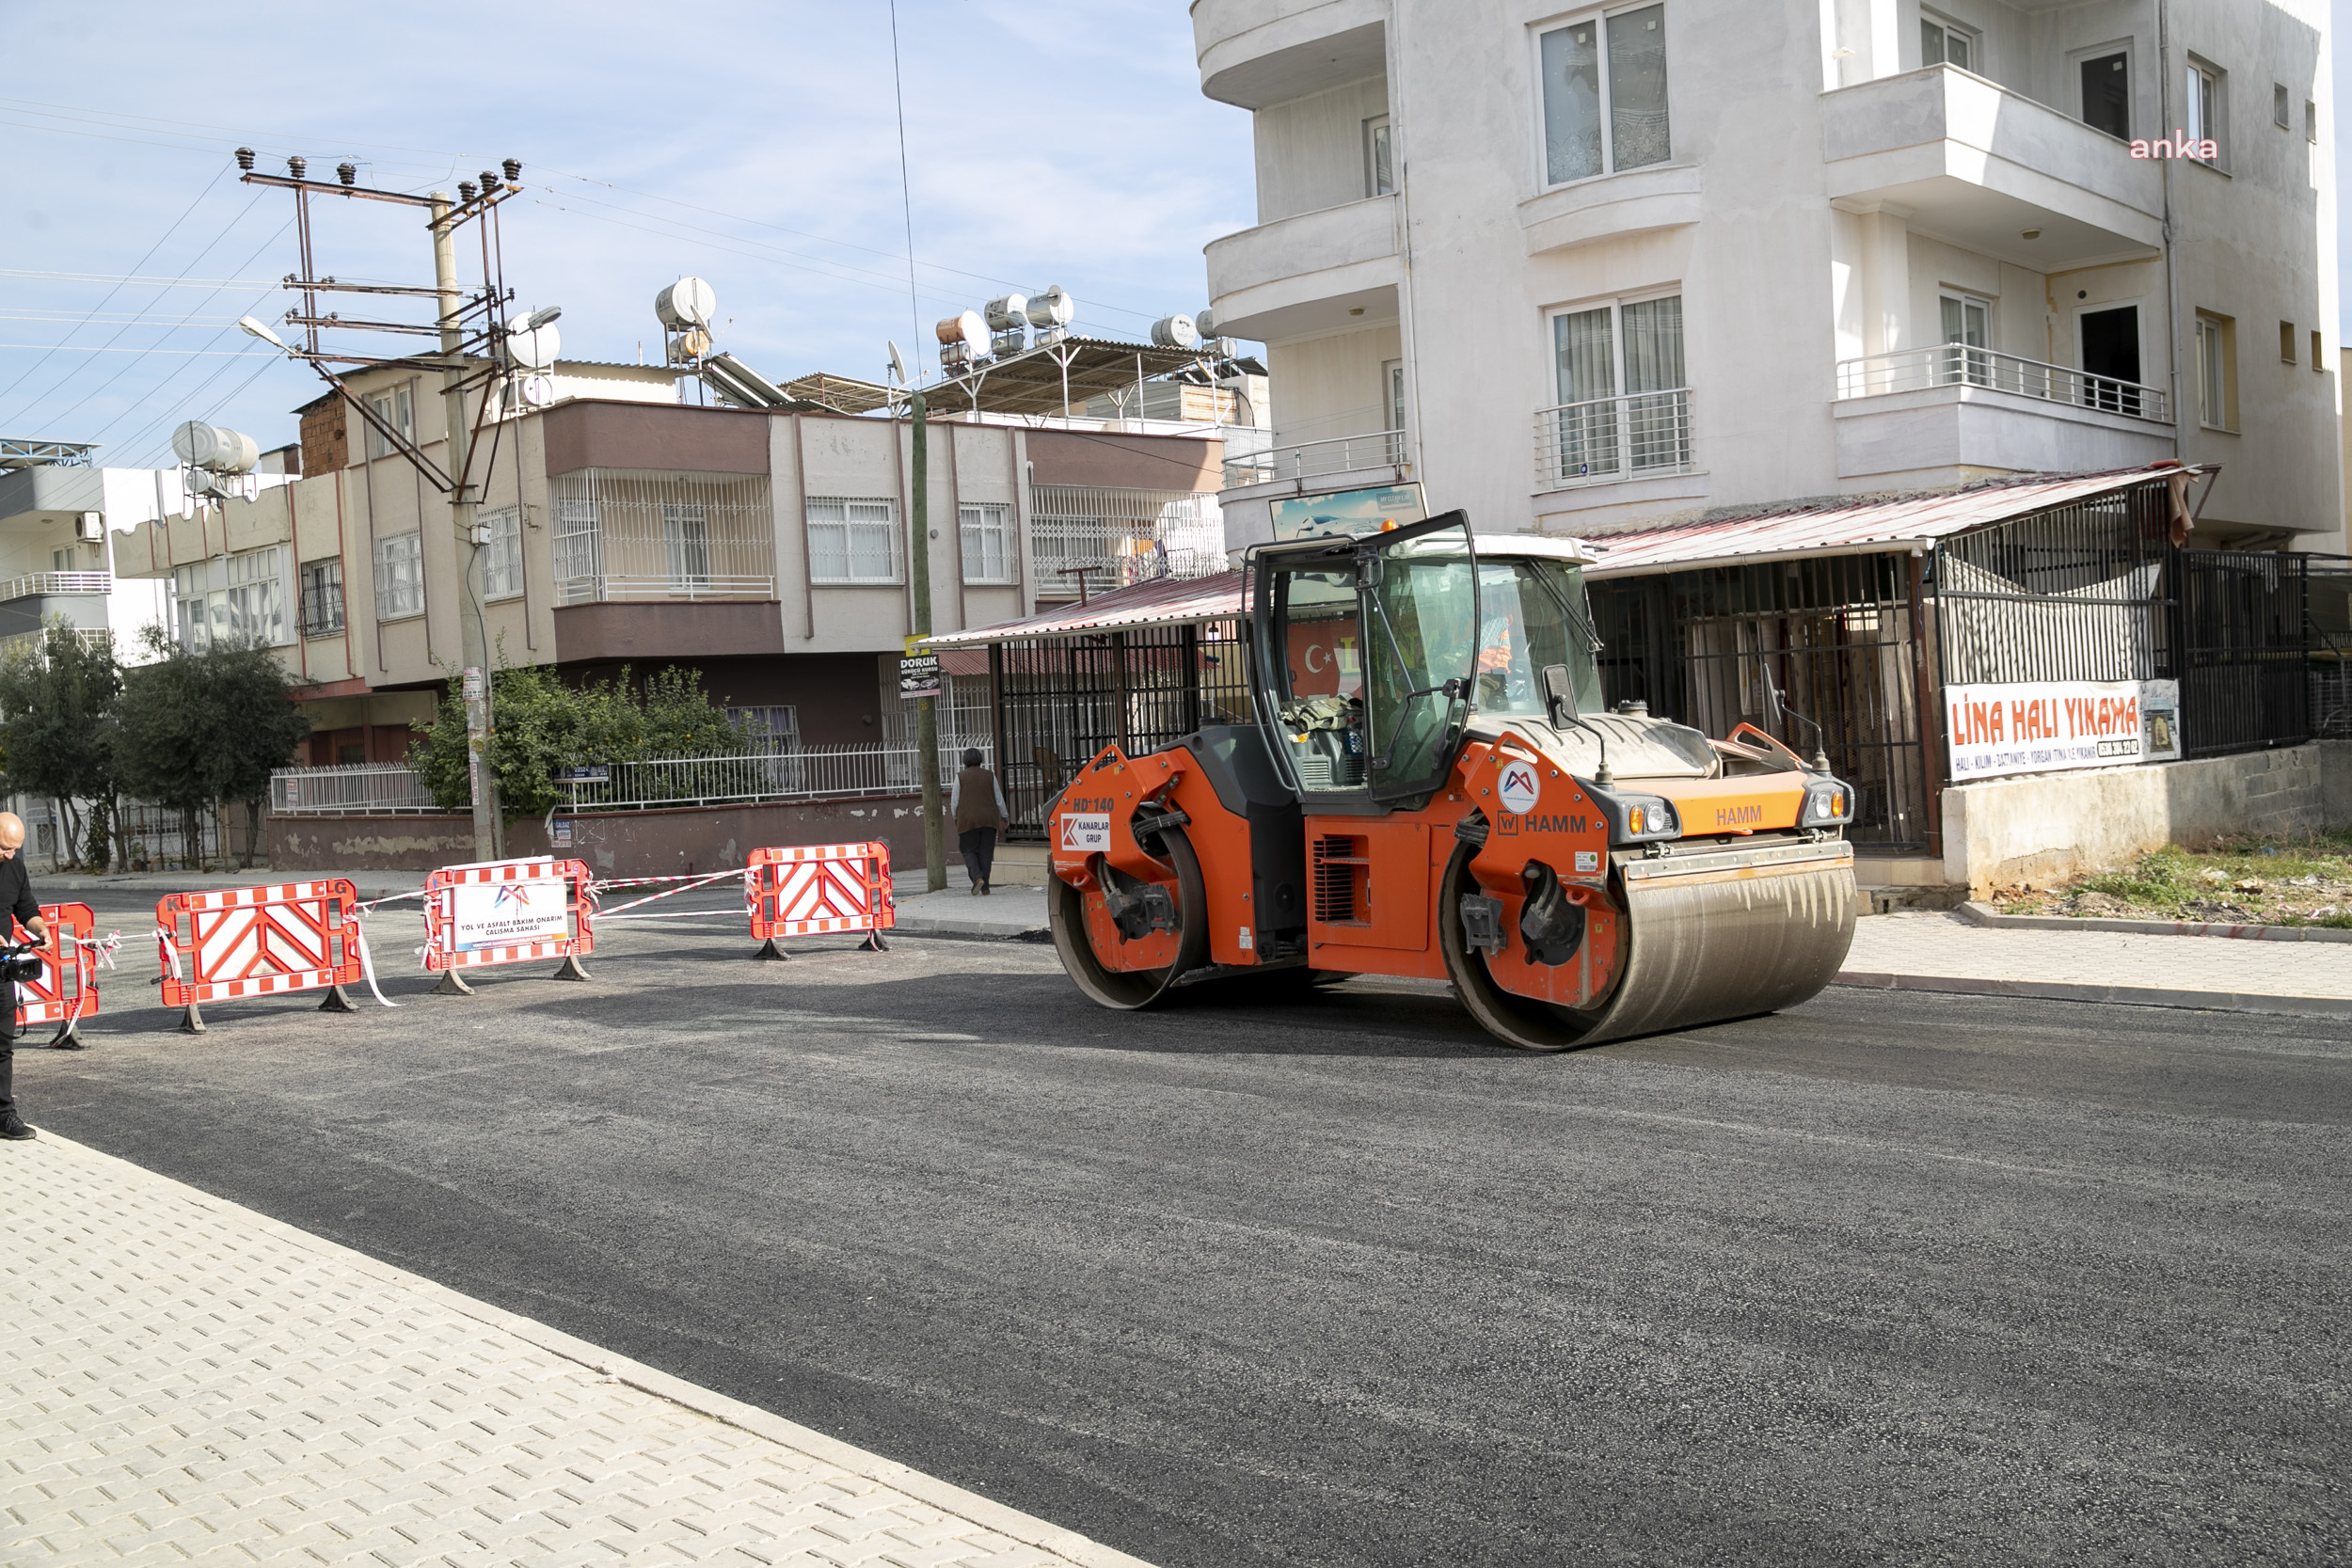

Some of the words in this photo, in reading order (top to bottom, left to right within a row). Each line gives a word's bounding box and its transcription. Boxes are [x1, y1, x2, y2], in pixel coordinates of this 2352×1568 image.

[900, 657, 938, 668] DORUK
[1953, 693, 2003, 746] LİNA
[2011, 698, 2058, 744] HALI
[2065, 696, 2137, 740] YIKAMA
[1716, 805, 1761, 826] HAMM
[1078, 822, 1109, 830] KANARLAR
[1525, 815, 1586, 833] HAMM
[1086, 834, 1101, 843] GRUP
[334, 882, 347, 895] G
[167, 898, 180, 912] K
[536, 915, 563, 923] ONARIM
